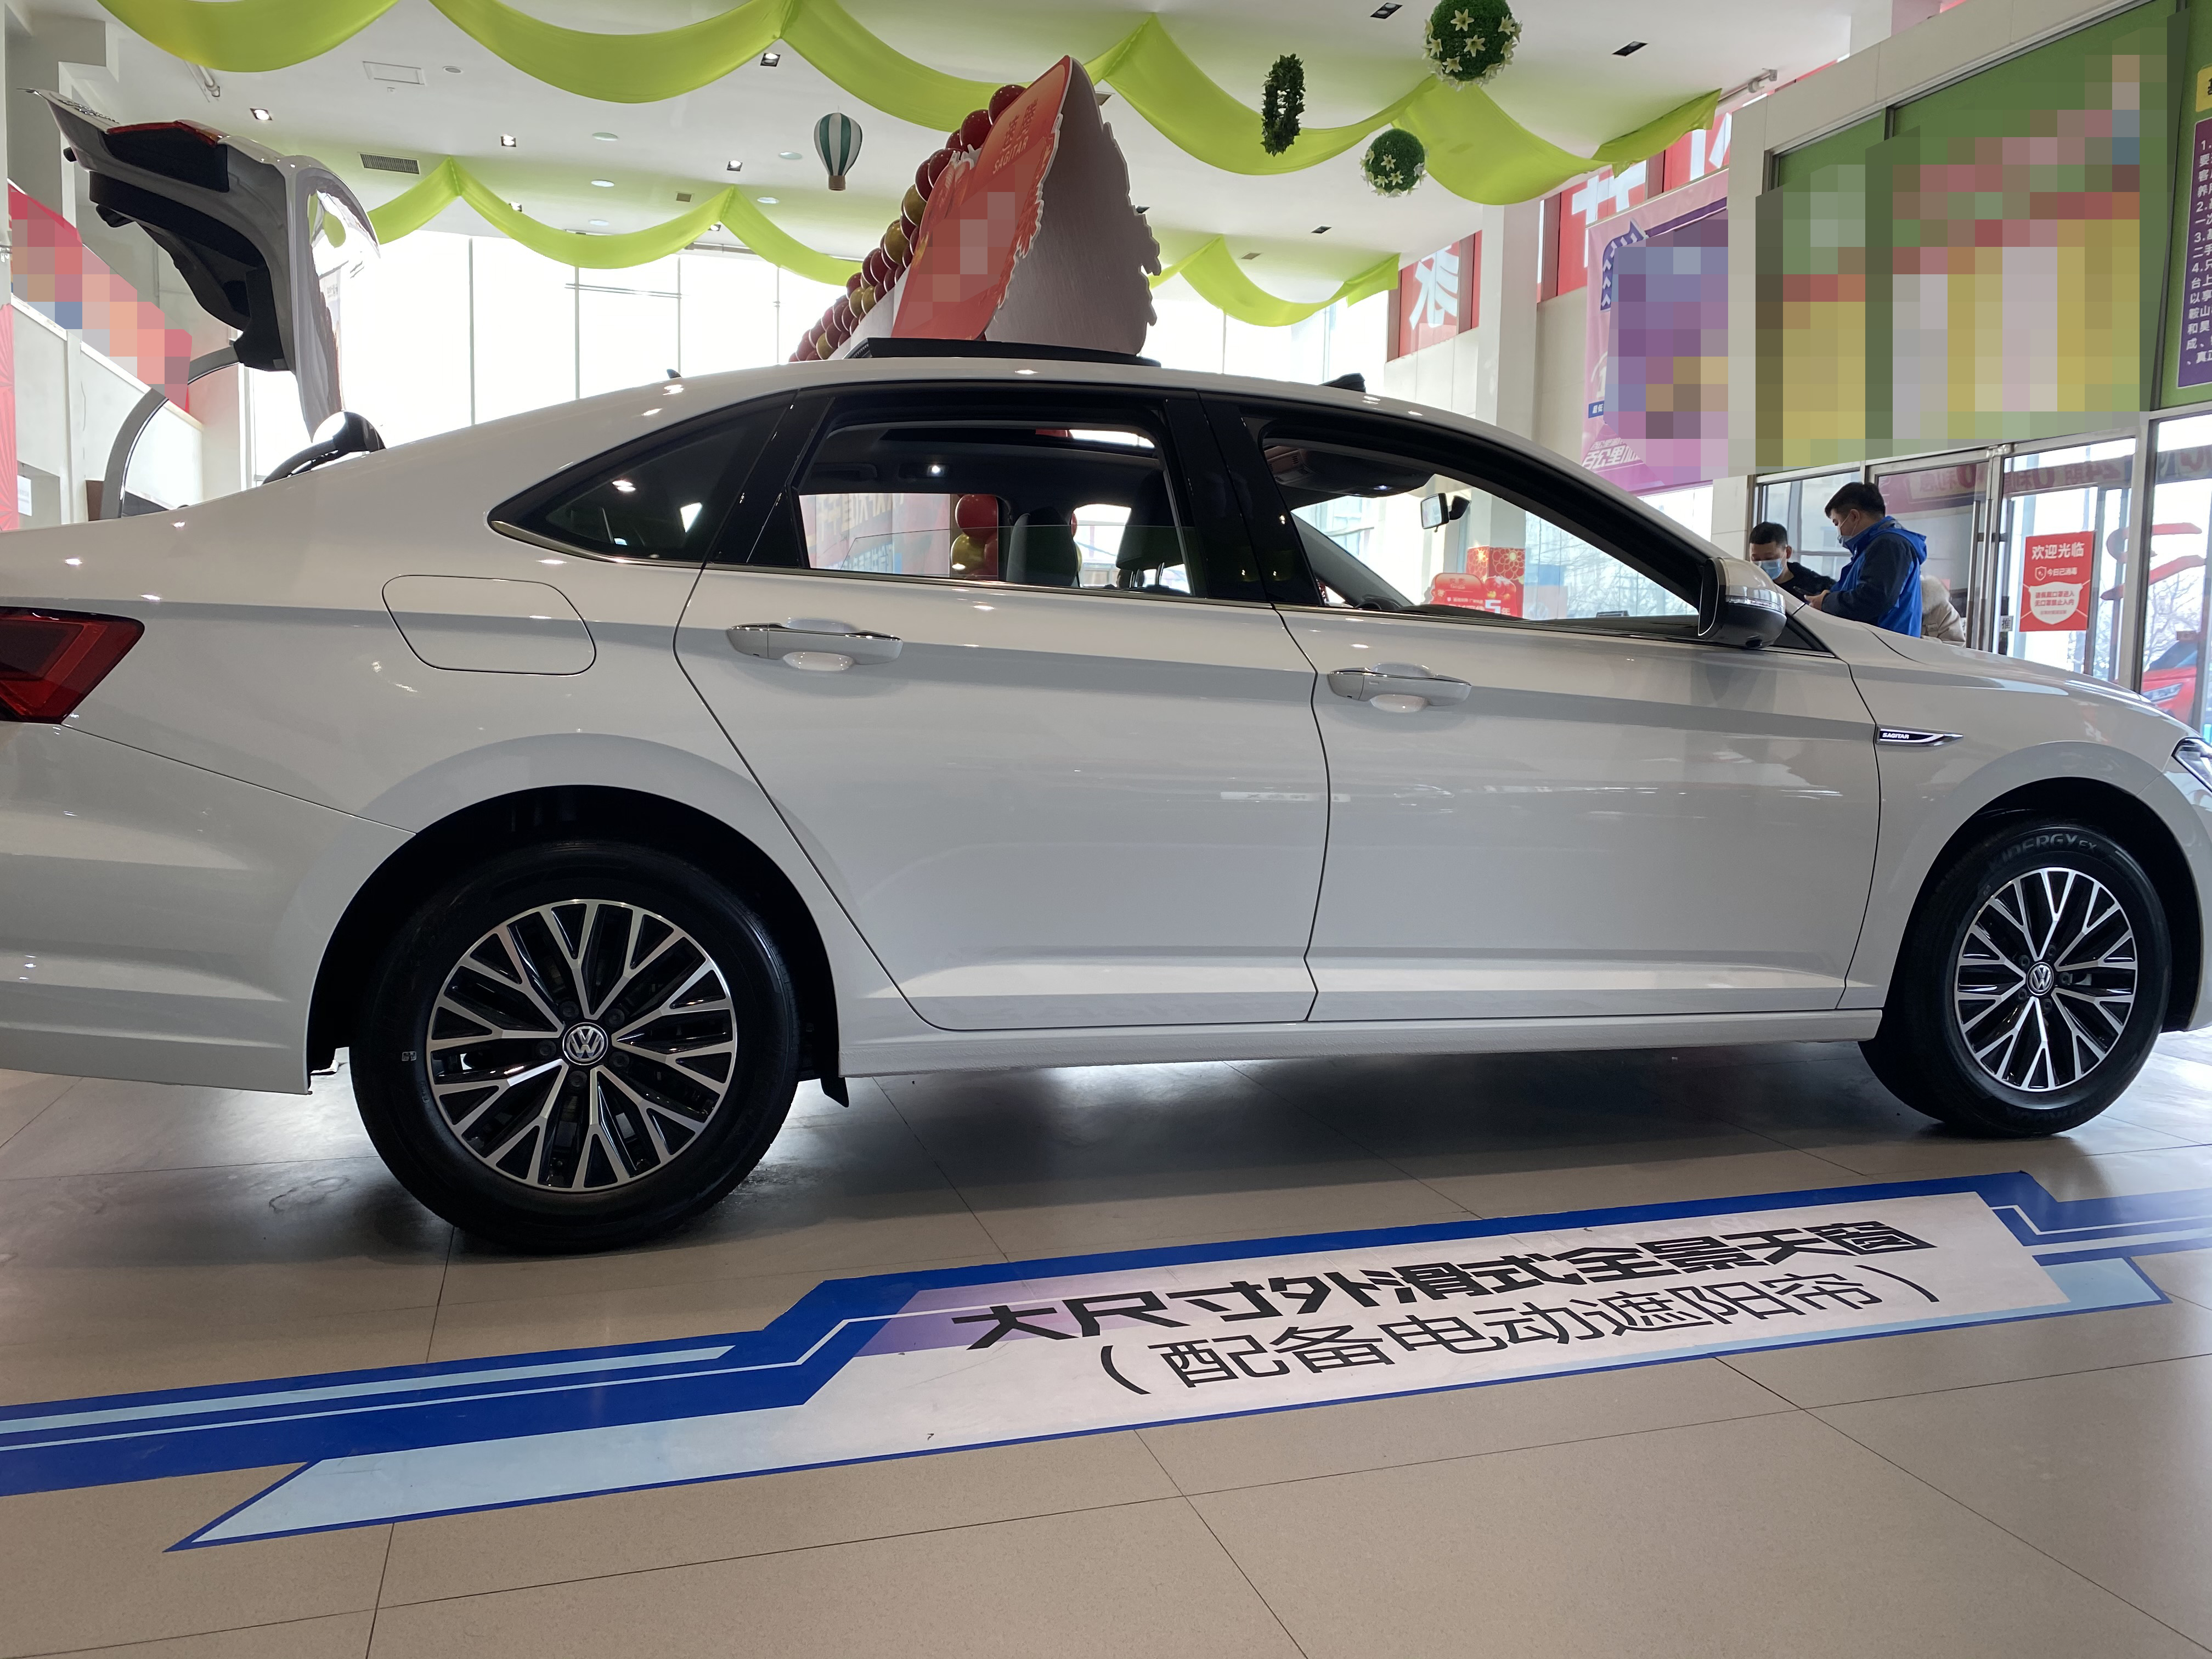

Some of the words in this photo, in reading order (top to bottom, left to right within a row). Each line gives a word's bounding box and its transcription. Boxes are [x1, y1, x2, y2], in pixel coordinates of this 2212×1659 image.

[992, 136, 1029, 174] SAGITAR
[2188, 305, 2212, 319] 鞍山
[2032, 541, 2085, 560] 欢迎光临
[2047, 567, 2078, 577] 今日已消毒
[2002, 618, 2011, 629] 推
[951, 1221, 1938, 1350] 大尺寸外滑式全景天窗
